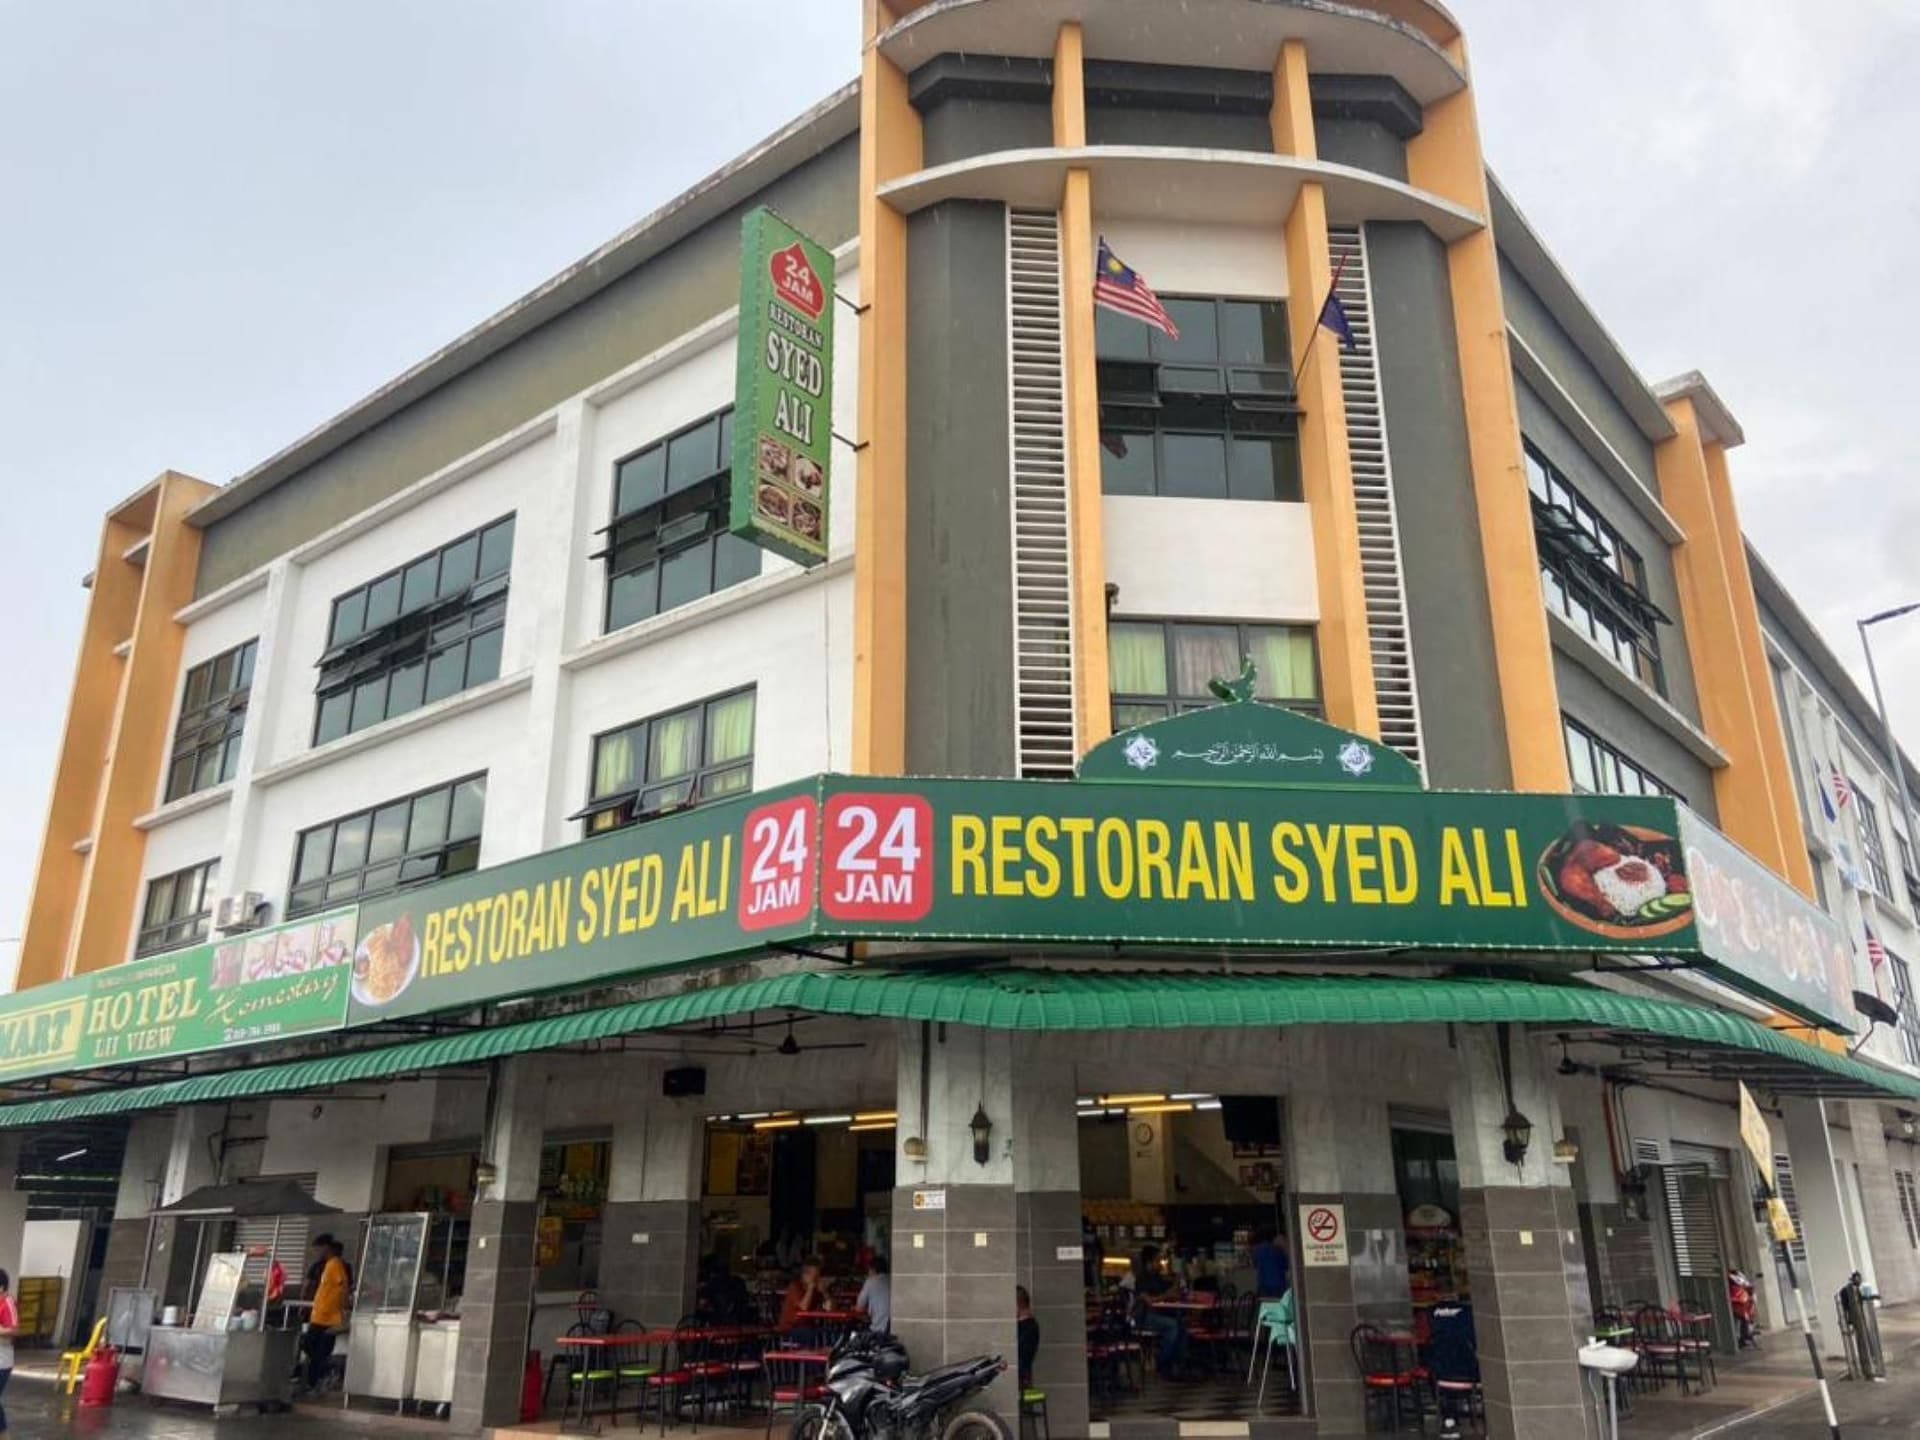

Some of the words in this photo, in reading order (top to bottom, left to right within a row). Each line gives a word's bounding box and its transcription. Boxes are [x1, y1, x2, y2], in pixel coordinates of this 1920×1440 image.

[781, 275, 813, 305] JAM
[785, 254, 810, 286] 24
[769, 301, 823, 348] RESTORAN
[768, 331, 821, 396] SYED
[775, 389, 811, 444] ALI
[750, 807, 808, 883] 24
[836, 806, 921, 873] 24
[951, 814, 1255, 901] RESTORAN
[1271, 821, 1419, 904] SYED
[1440, 827, 1528, 907] ALI
[420, 885, 569, 978] RESTORAN
[576, 851, 663, 944] SYED
[670, 834, 732, 922] ALI
[747, 876, 801, 915] JAM
[835, 872, 914, 904] JAM
[88, 978, 200, 1035] HOTEL
[127, 1025, 176, 1052] VIEW
